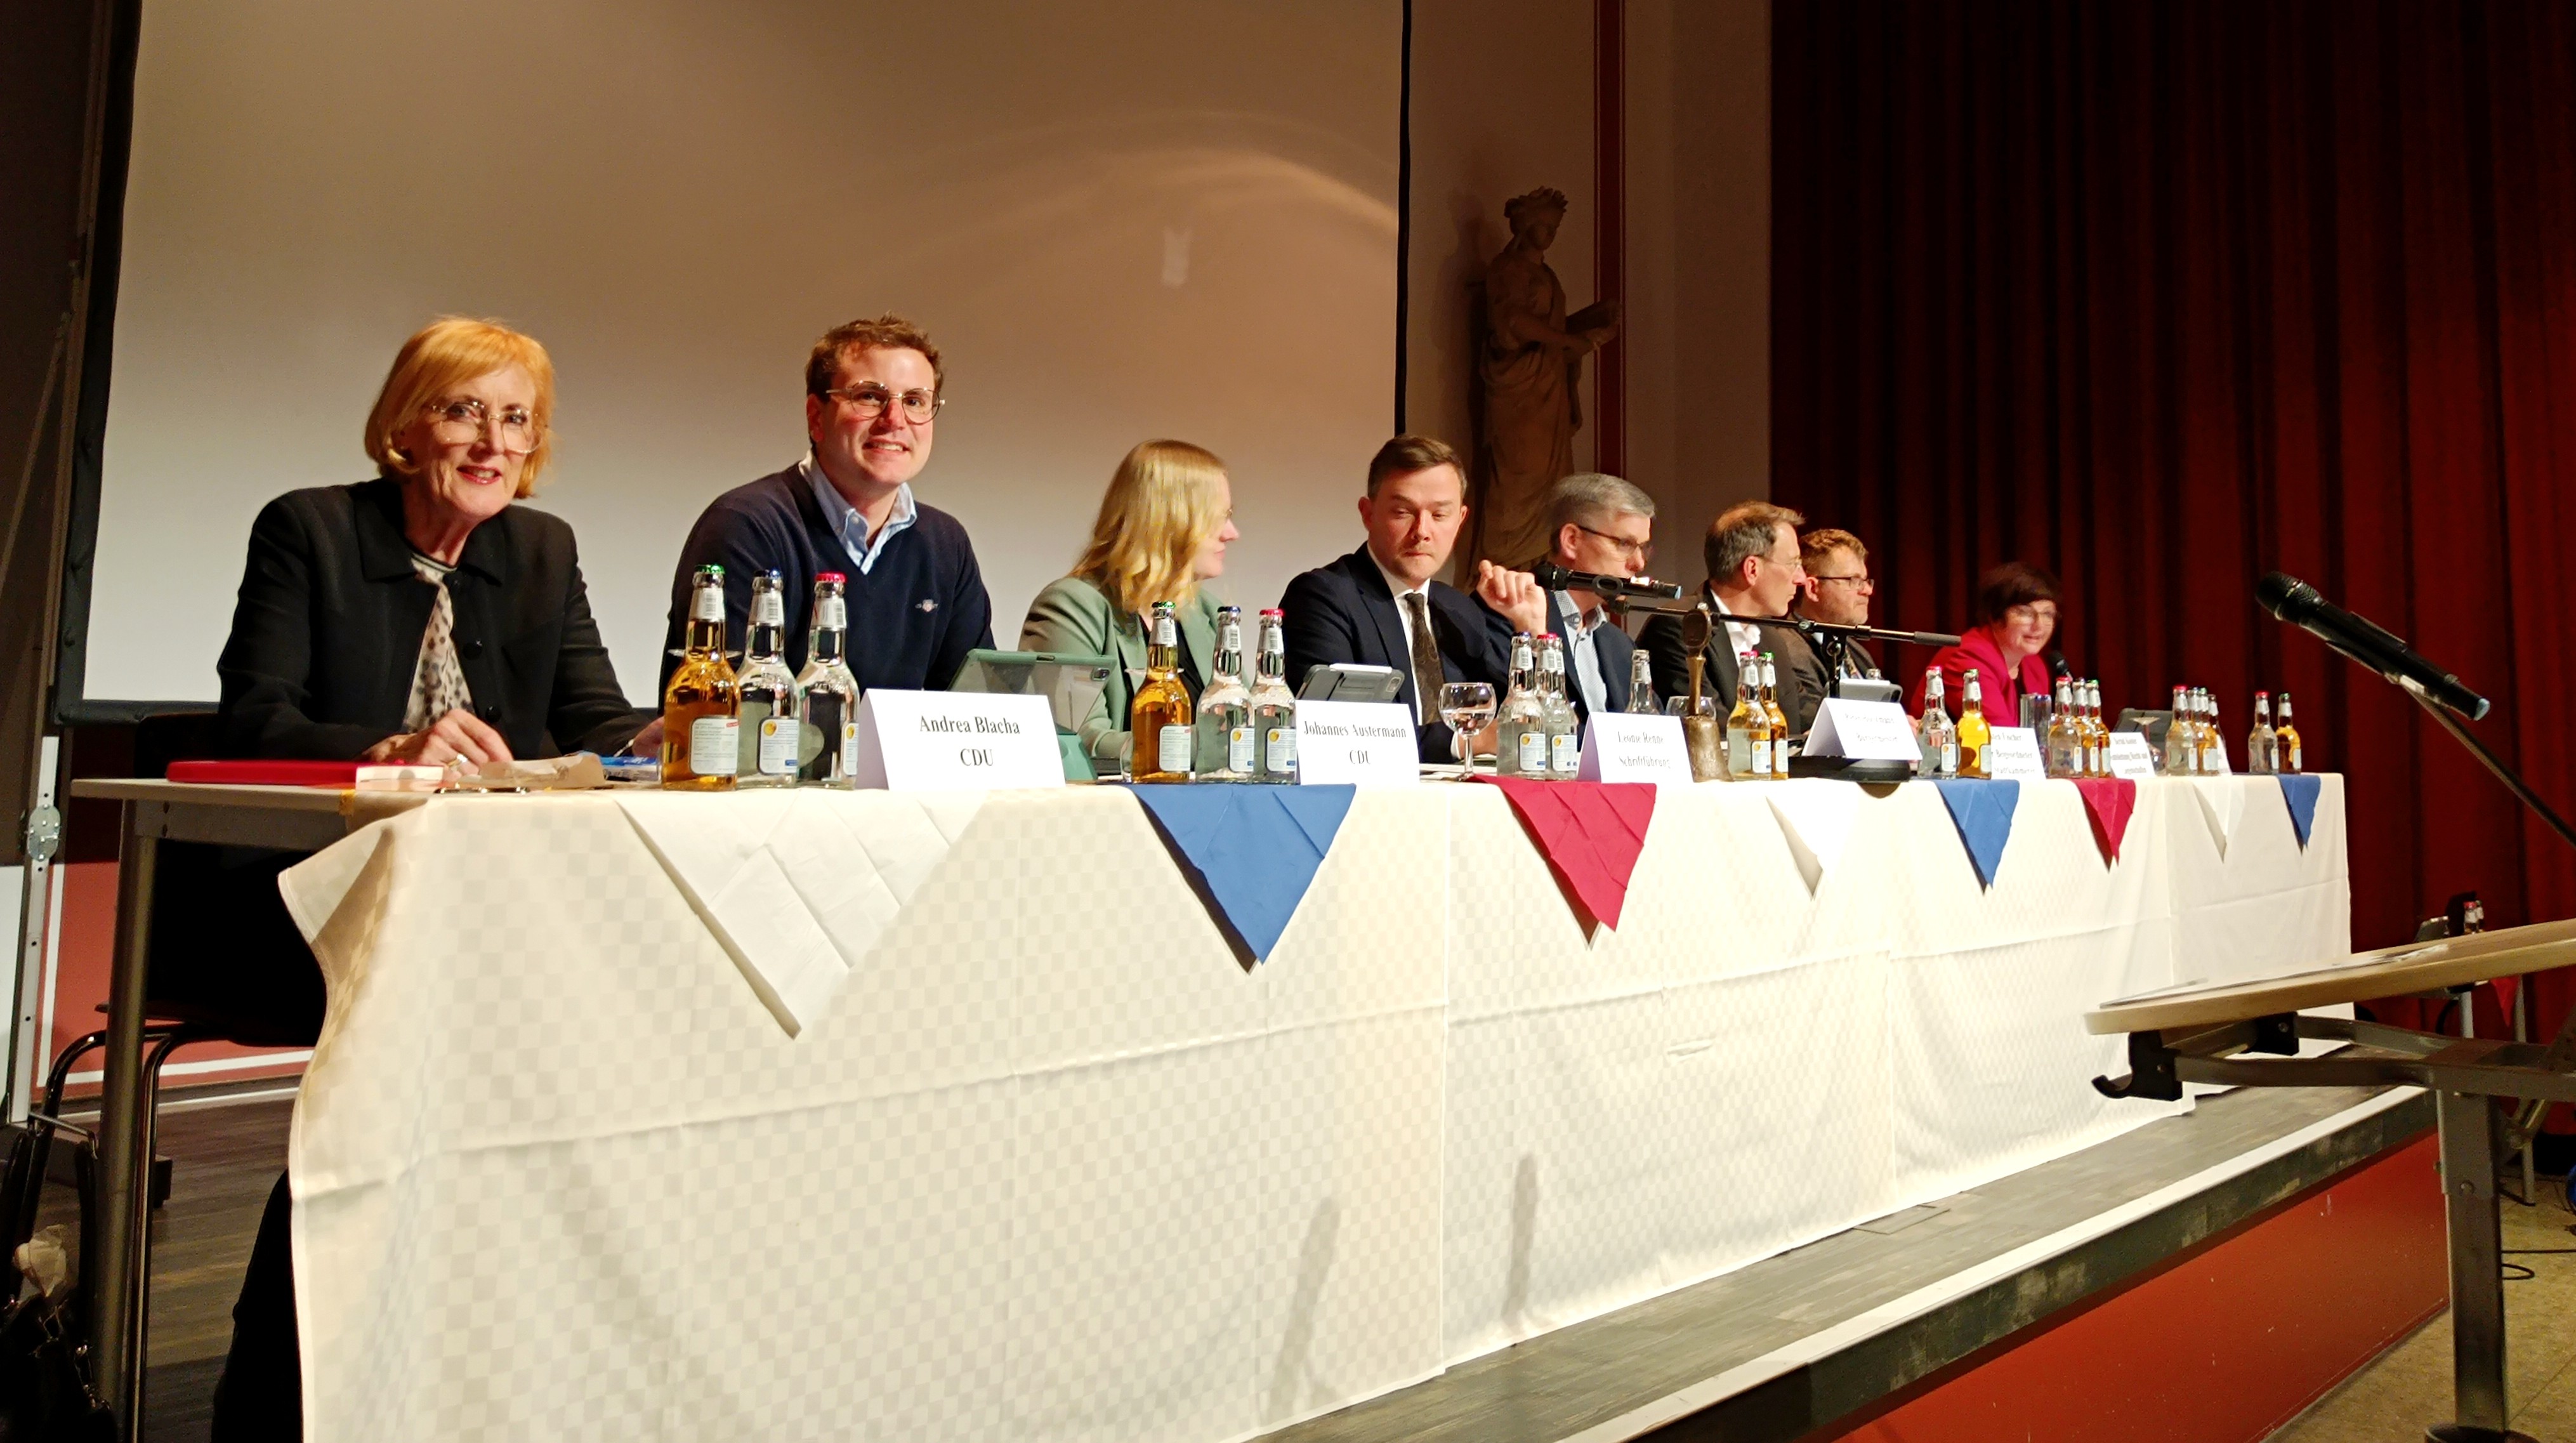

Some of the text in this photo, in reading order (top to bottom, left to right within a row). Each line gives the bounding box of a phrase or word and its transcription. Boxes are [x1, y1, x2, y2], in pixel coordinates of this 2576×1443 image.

[920, 715, 1020, 734] Andrea Blacha
[1304, 721, 1407, 738] Johannes Austermann
[960, 748, 994, 766] CDU
